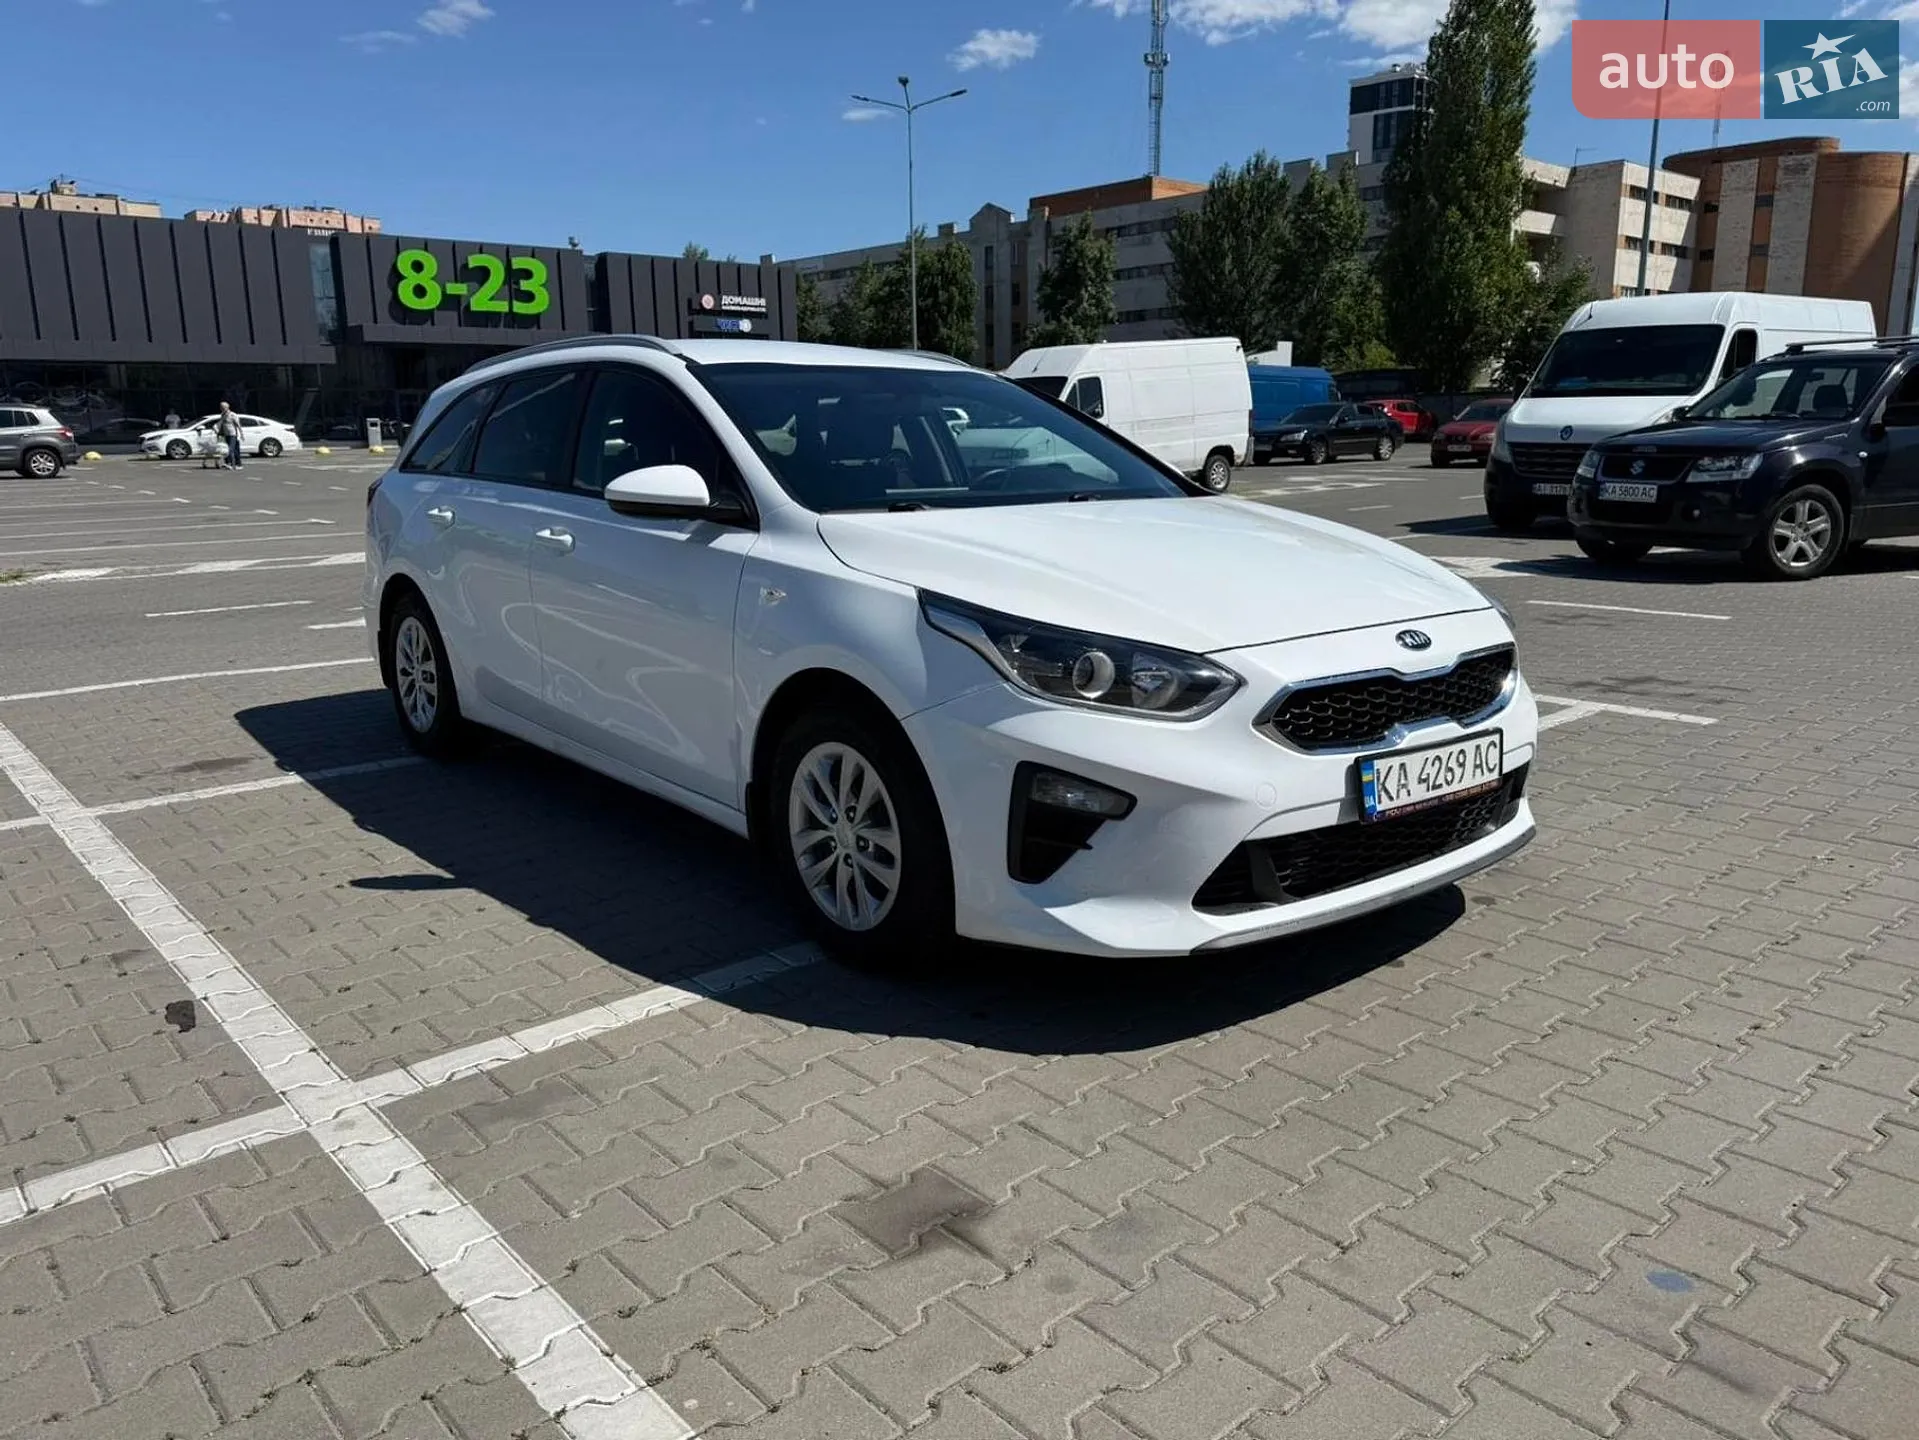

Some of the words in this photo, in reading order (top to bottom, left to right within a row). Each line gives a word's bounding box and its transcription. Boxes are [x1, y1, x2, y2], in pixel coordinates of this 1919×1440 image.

[396, 249, 550, 315] 8-23
[1400, 631, 1430, 646] KIA
[1376, 762, 1411, 804] KA
[1418, 748, 1467, 792] 4269
[1472, 740, 1498, 779] AC
[1364, 794, 1376, 808] UA
